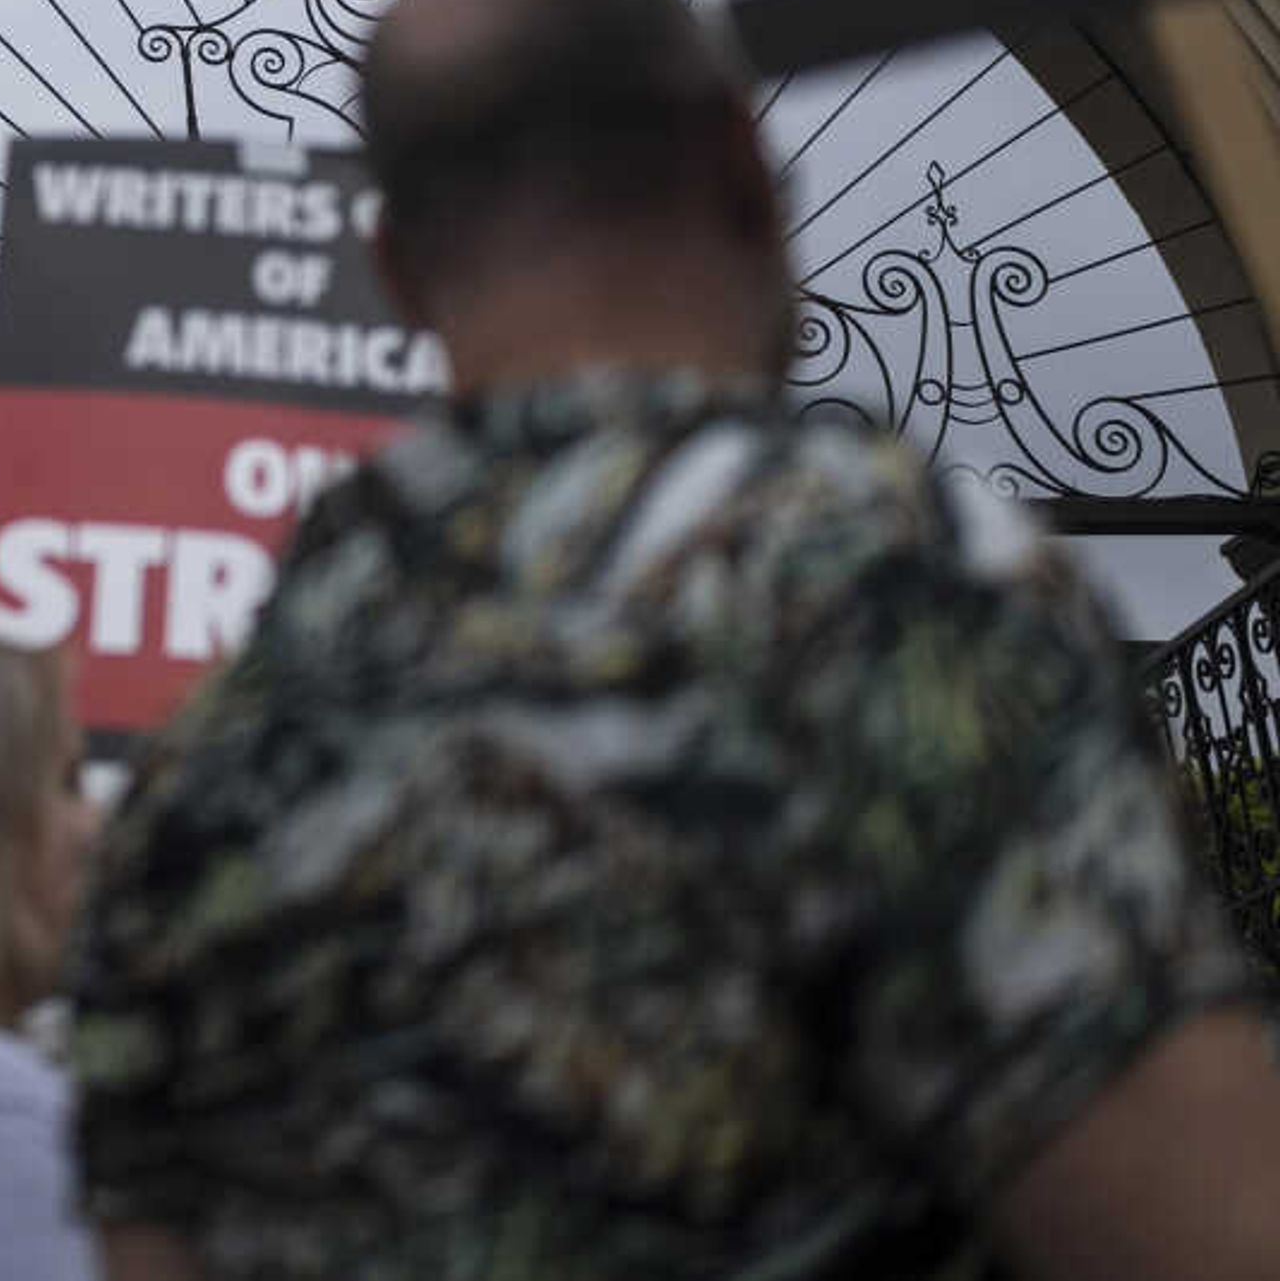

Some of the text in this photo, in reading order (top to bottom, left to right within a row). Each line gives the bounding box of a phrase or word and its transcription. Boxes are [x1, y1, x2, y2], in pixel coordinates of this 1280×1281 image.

[32, 162, 342, 242] WRITERS
[251, 249, 332, 306] OF
[124, 305, 456, 392] AMERICA
